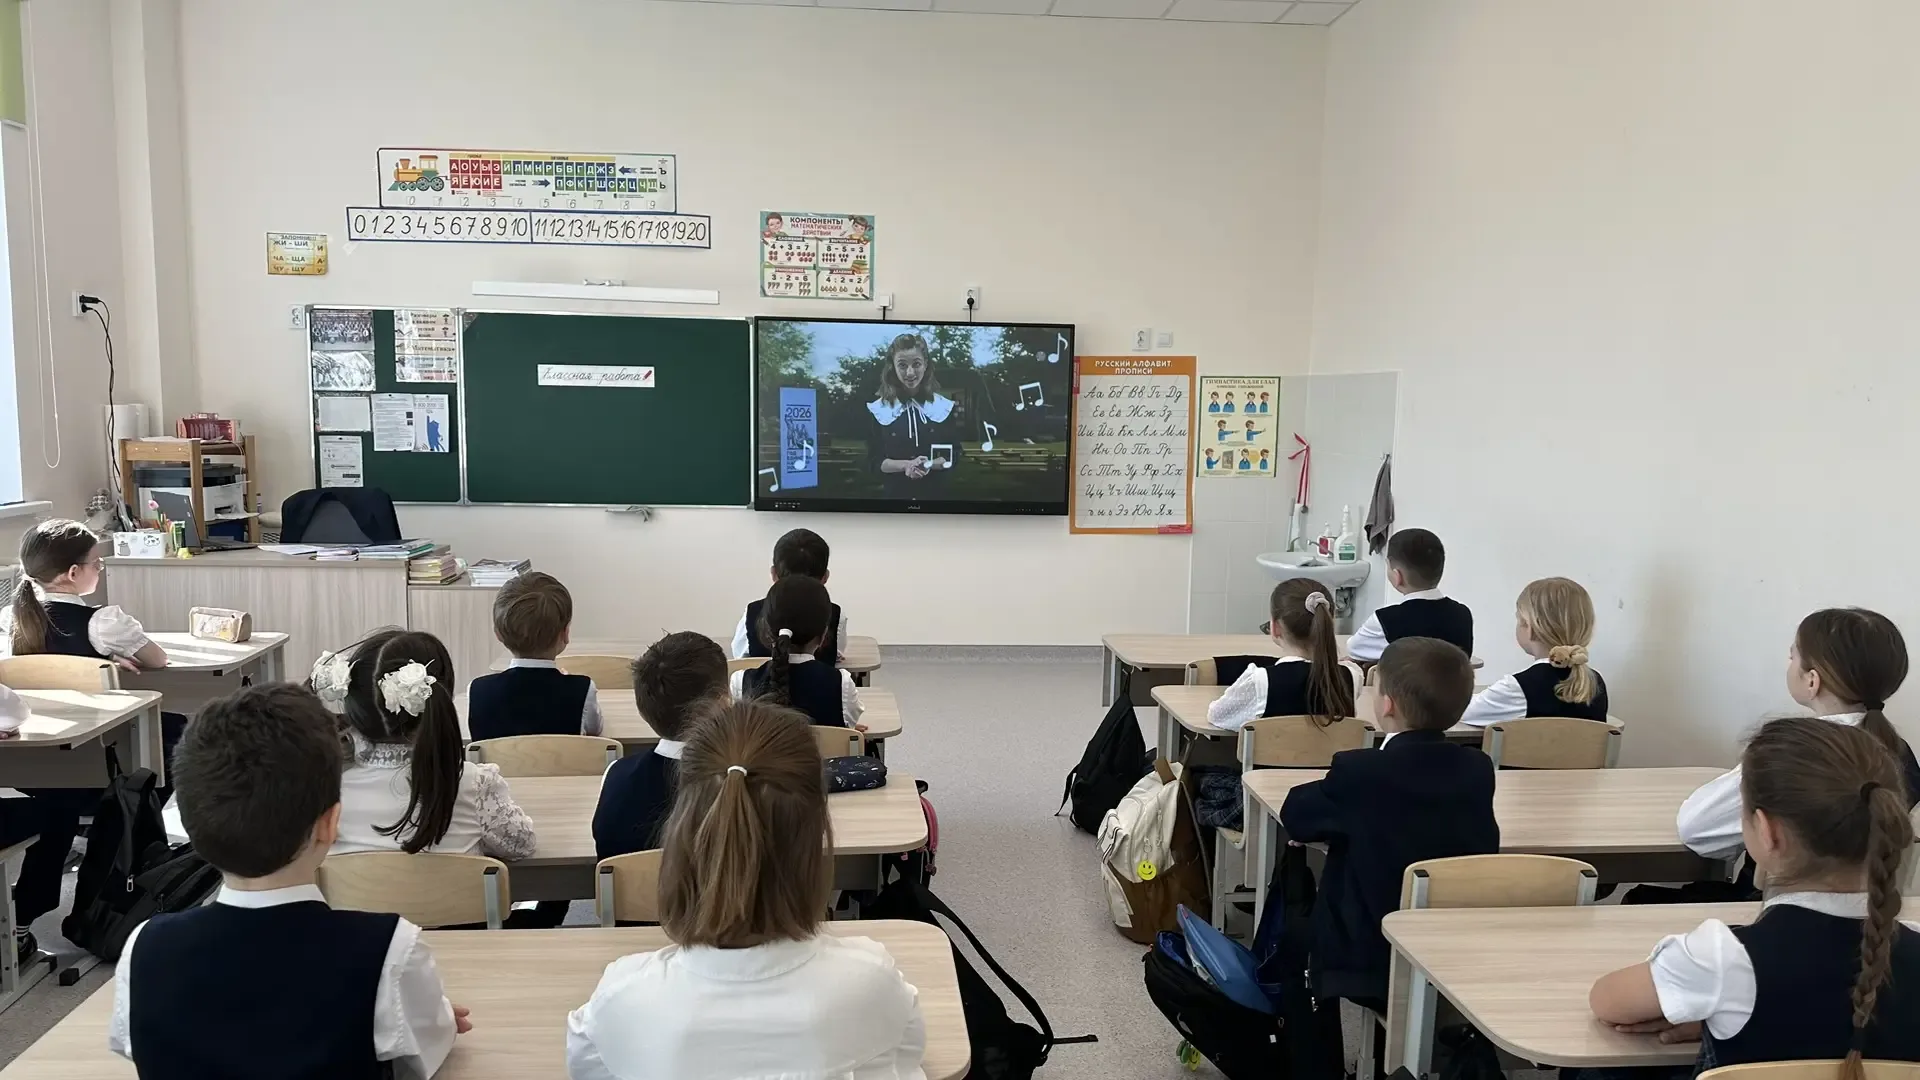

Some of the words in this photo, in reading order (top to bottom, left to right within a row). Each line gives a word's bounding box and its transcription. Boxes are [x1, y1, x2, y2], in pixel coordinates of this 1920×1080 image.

[354, 215, 366, 233] 0
[372, 215, 378, 234] 1
[384, 215, 395, 234] 2
[401, 216, 412, 234] 3
[417, 216, 427, 234] 4
[434, 216, 445, 235] 5
[450, 217, 462, 235] 6
[466, 217, 476, 235] 7
[480, 217, 492, 236] 8
[496, 218, 507, 236] 9
[511, 218, 528, 236] 10
[535, 218, 547, 236] 11
[550, 219, 566, 237] 12
[568, 219, 584, 237] 13
[586, 220, 600, 238] 14
[604, 220, 619, 238] 15
[621, 220, 636, 239] 16
[637, 221, 653, 239] 17
[654, 221, 668, 240] 18
[672, 222, 686, 240] 19
[687, 222, 706, 240] 20
[542, 366, 592, 381] Классная
[597, 368, 642, 384] работа
[1084, 386, 1104, 398] Аа
[1108, 386, 1130, 398] Бб
[1128, 386, 1145, 398] Вв
[1148, 386, 1160, 398] Гг
[786, 407, 811, 418] 2026
[1093, 405, 1105, 417] Ее
[1126, 405, 1156, 417] Жж
[1092, 443, 1110, 454] Нн
[1114, 443, 1127, 454] Оо
[1131, 443, 1150, 454] Пп
[1156, 443, 1172, 459] Рр
[1080, 464, 1092, 476] Сс
[1096, 464, 1121, 476] Тт
[1125, 464, 1137, 480] Уу
[1162, 464, 1183, 476] Хх
[1132, 504, 1152, 516] Юю
[1155, 504, 1173, 516] Яя
